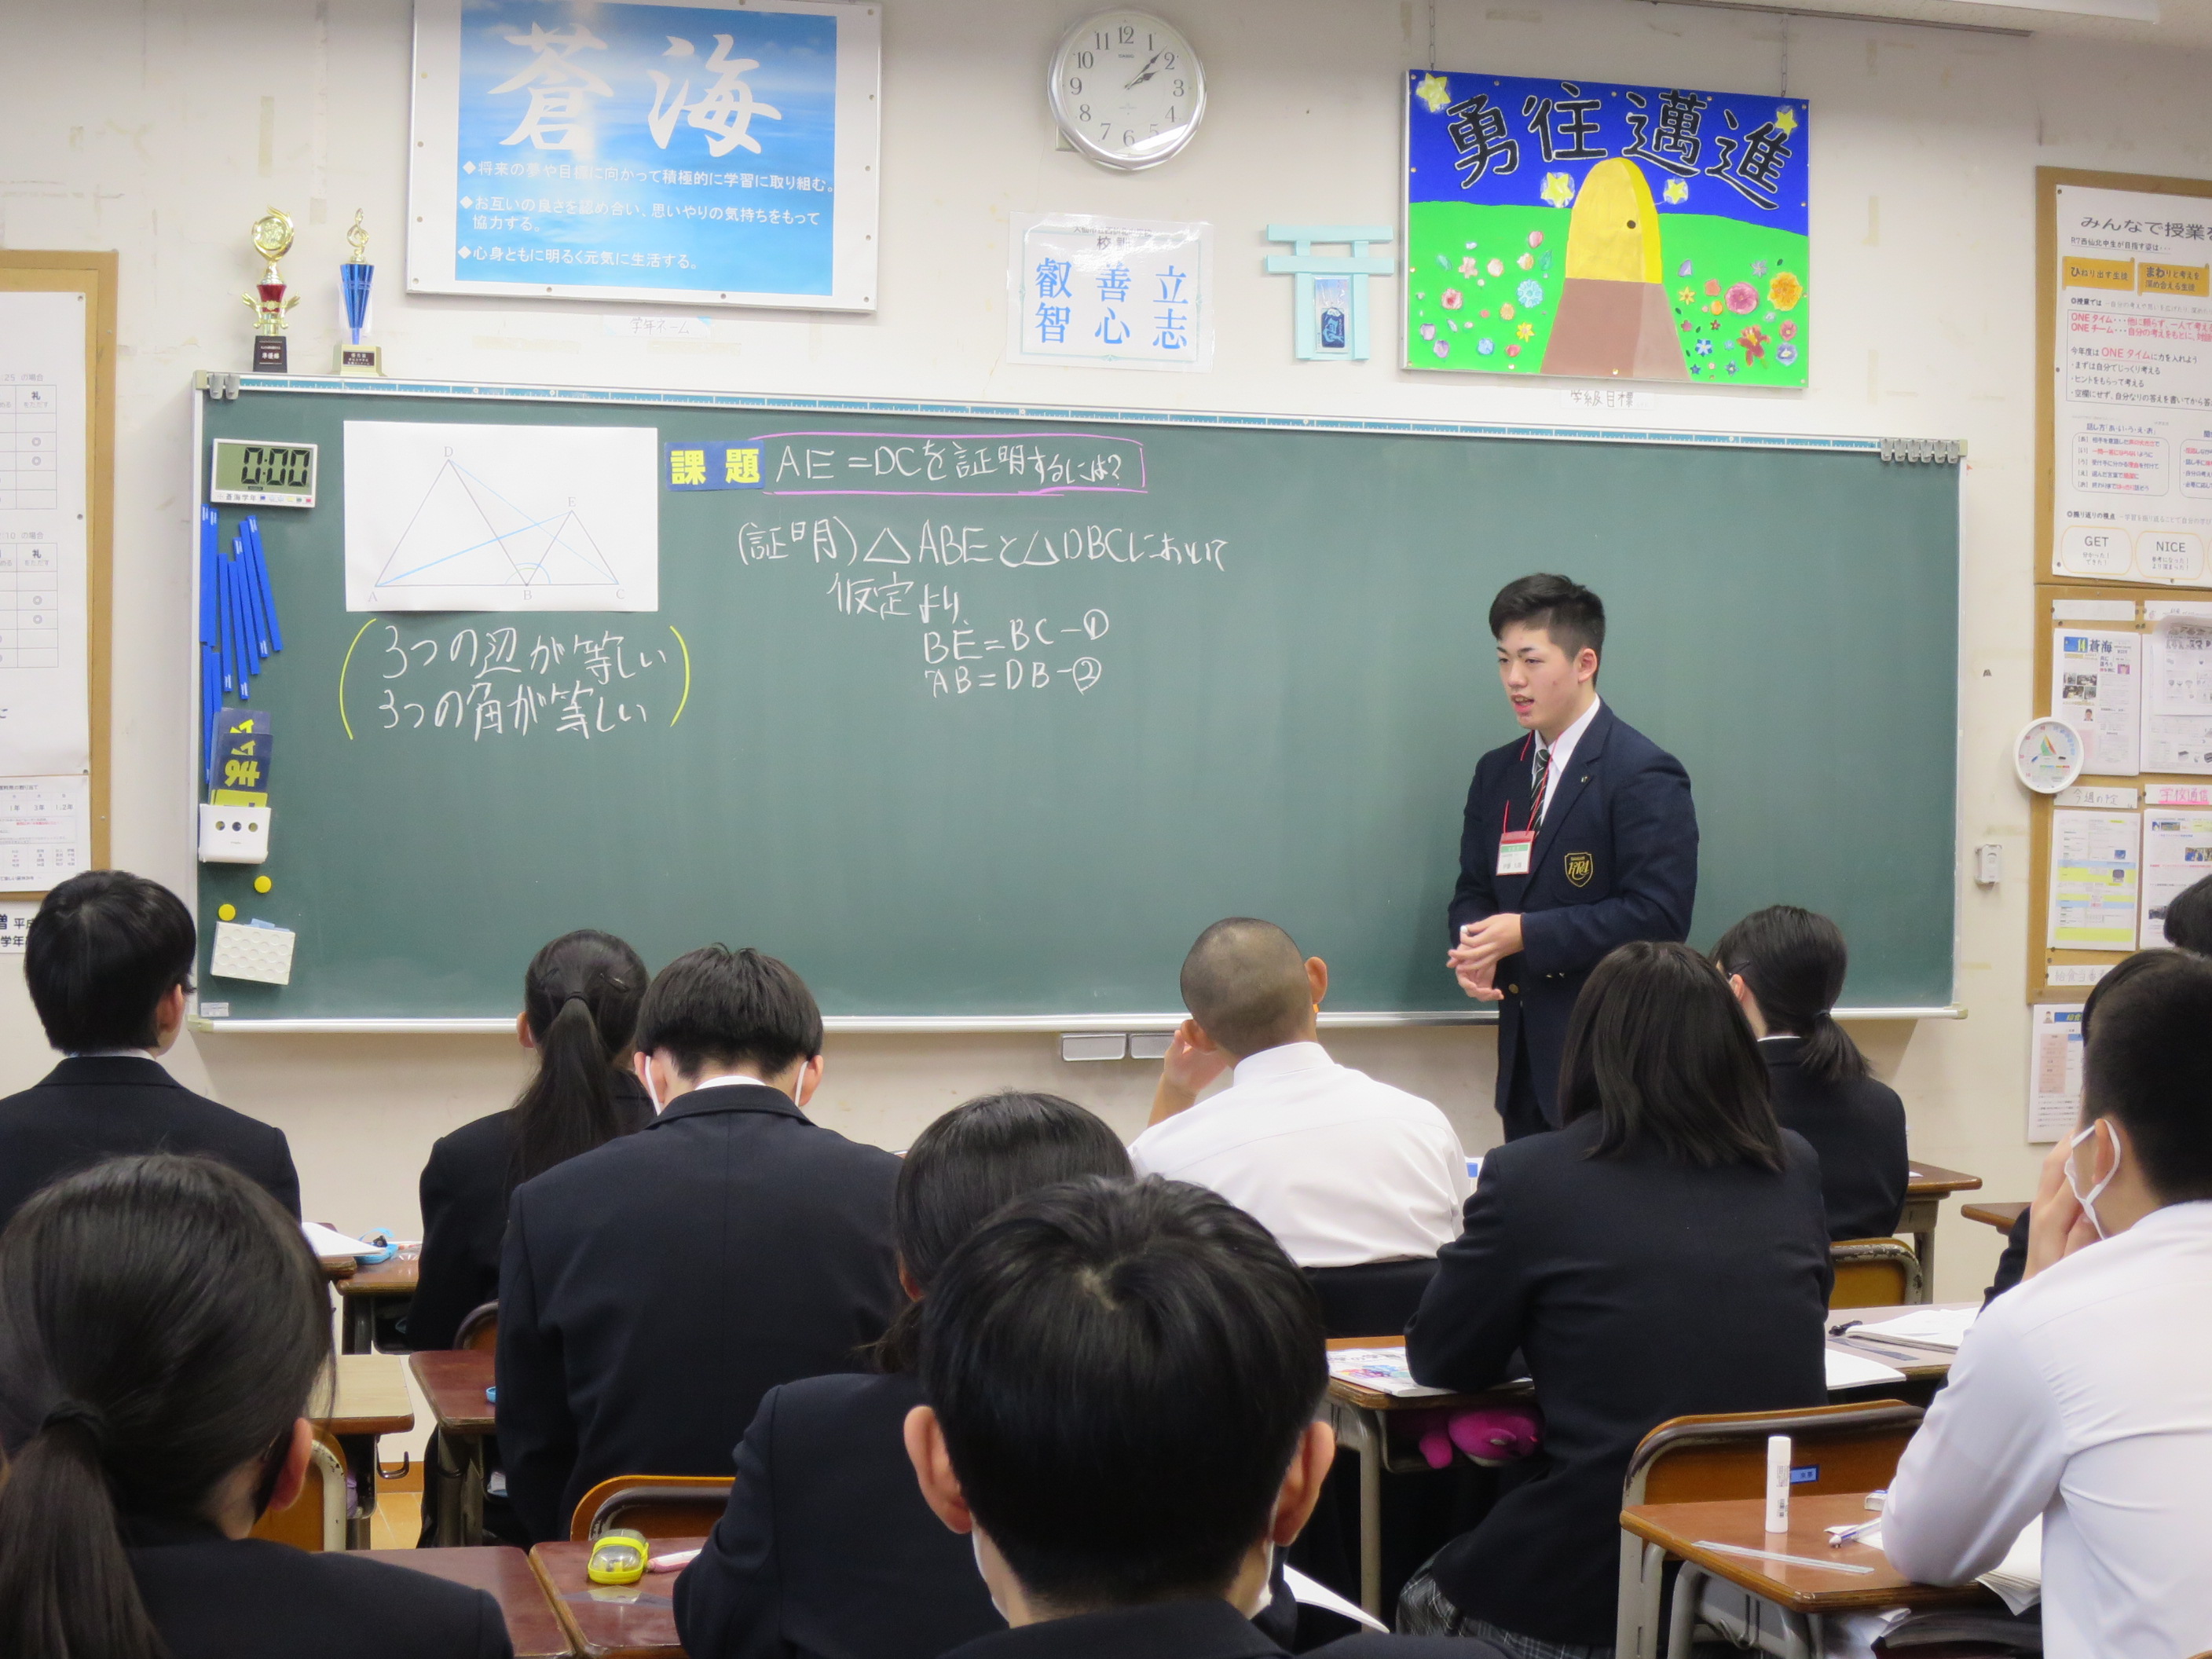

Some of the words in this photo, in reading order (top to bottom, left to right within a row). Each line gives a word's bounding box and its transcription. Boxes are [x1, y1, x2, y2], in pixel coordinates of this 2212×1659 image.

[1095, 32, 1109, 50] 11
[1118, 25, 1134, 44] 12
[1148, 34, 1154, 51] 1
[1077, 51, 1093, 69] 10
[1164, 52, 1175, 70] 2
[487, 22, 782, 157] 蒼海
[1070, 77, 1082, 95] 9
[1173, 79, 1185, 97] 3
[1079, 104, 1091, 122] 8
[1165, 105, 1176, 123] 4
[1100, 123, 1111, 140] 7
[1123, 129, 1135, 147] 6
[1445, 81, 1794, 211] 勇往邁進
[478, 160, 833, 193] 将来の夢や目標に向かって積極的に学習に取り組む。
[475, 195, 820, 225] お互いの良さを認め合い、思いやりの気持ちをもって
[473, 214, 541, 233] 協力する。
[473, 246, 697, 270] 心身ともに明るく元気に生活する。
[2071, 266, 2129, 281] ひねり出す生徒
[2146, 266, 2200, 280] まわりと考えを
[1035, 257, 1073, 344] 叡智
[1094, 261, 1132, 345] 善心
[1152, 265, 1189, 350] 立志
[630, 316, 690, 335] 学年ネーム
[2071, 313, 2090, 322] ONE
[2071, 323, 2089, 332] ONE
[2071, 346, 2099, 357] 今年度は
[2101, 347, 2123, 358] ONE
[2126, 349, 2198, 364] タイムに力を入れよう
[21, 373, 44, 382] の場合
[31, 391, 41, 401] 礼
[1570, 389, 1634, 408] 学級目標
[444, 447, 453, 457] D
[241, 447, 310, 487] 0:00
[670, 448, 760, 485] 課題
[568, 497, 576, 507] E
[2084, 536, 2109, 548] GET
[2155, 540, 2186, 553] NICE
[32, 549, 42, 559] 礼
[368, 591, 378, 602] A
[523, 590, 532, 600] B
[616, 589, 625, 599] C
[382, 625, 666, 685] 3つの辺が等しい
[378, 680, 646, 742] 3つの角が等しい
[2074, 788, 2119, 806] 今週の予定
